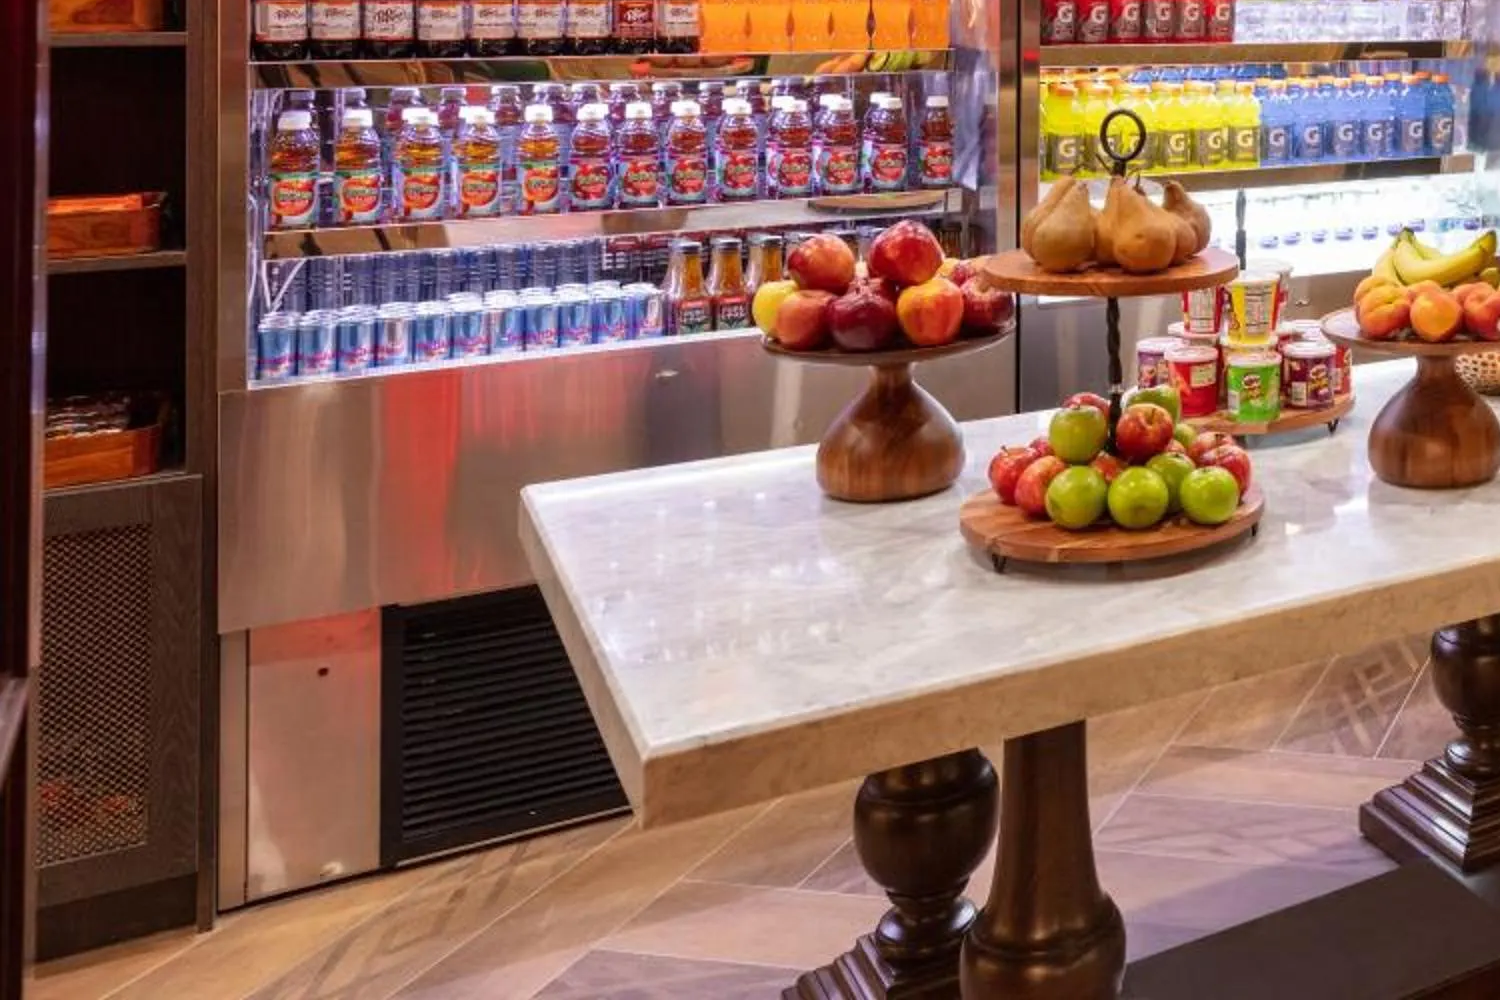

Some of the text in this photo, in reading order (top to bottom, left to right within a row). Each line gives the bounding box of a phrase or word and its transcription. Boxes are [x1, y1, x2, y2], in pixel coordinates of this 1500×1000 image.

[1058, 4, 1073, 22] G
[1091, 5, 1107, 24] G
[1123, 2, 1140, 21] G
[1156, 2, 1171, 20] G
[1183, 2, 1200, 20] G
[1215, 2, 1231, 20] G
[1237, 129, 1253, 147] G
[1269, 128, 1285, 146] G
[1303, 126, 1320, 144] G
[1338, 124, 1354, 141] G
[1368, 123, 1383, 141] G
[1409, 121, 1423, 137] G
[1059, 139, 1075, 156] G
[1169, 133, 1185, 151] G
[1208, 131, 1223, 149] G
